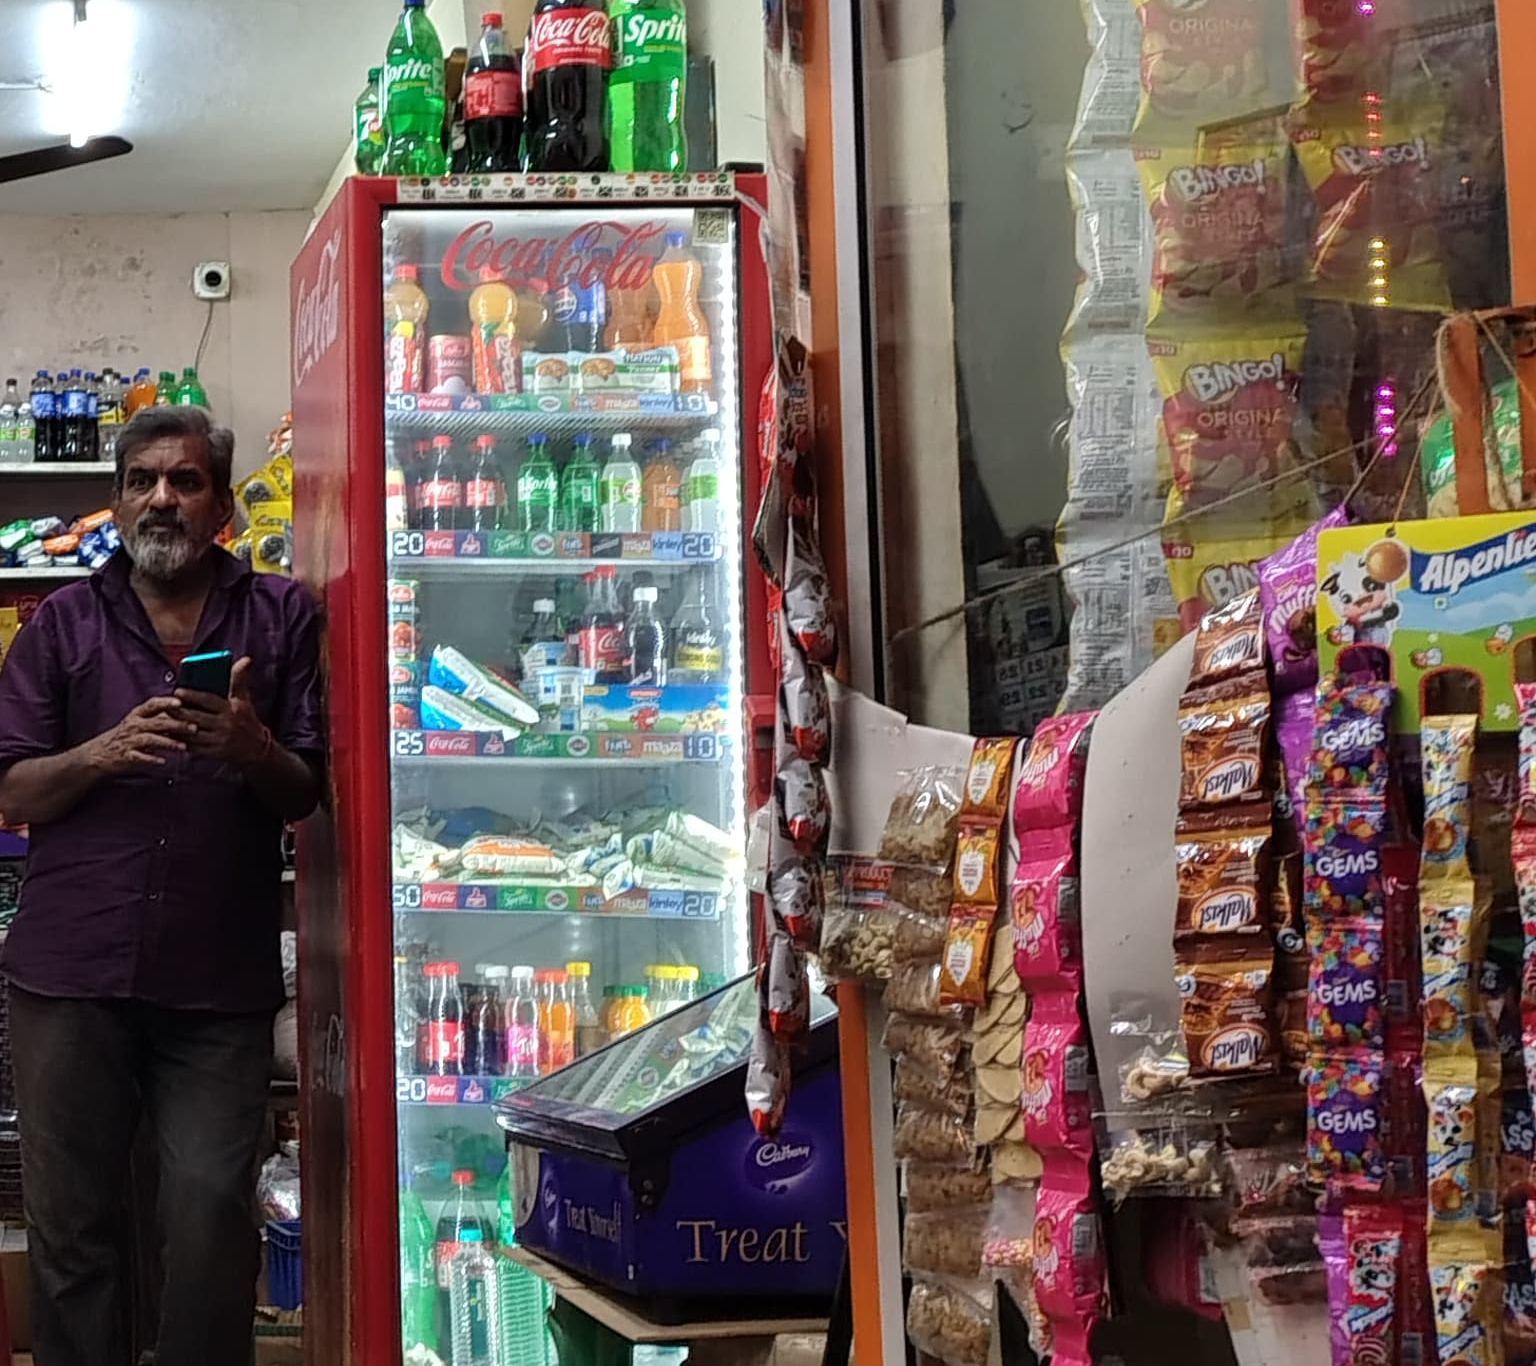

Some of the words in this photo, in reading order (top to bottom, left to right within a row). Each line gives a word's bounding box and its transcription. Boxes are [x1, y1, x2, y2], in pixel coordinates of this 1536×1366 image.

[1169, 158, 1266, 203] BINGO!
[441, 220, 669, 292] Coca-Cola
[1186, 354, 1285, 403] BINGO!
[394, 532, 424, 554] 20
[682, 535, 714, 556] 20
[395, 732, 423, 755] 25
[428, 737, 472, 751] Coca-Cola
[687, 737, 714, 757] 10
[1205, 762, 1254, 798] Malkist
[1315, 851, 1378, 878] GEMS
[423, 890, 457, 904] Coca-Cola
[683, 893, 714, 916] 20
[1200, 893, 1252, 930] Malkist
[1318, 980, 1377, 1006] GEMS
[1213, 1030, 1264, 1065] Malkist
[395, 1078, 427, 1100] 20
[1317, 1108, 1376, 1135] GEMS
[755, 1142, 810, 1168] Cadbury
[676, 1219, 811, 1263] Treat
